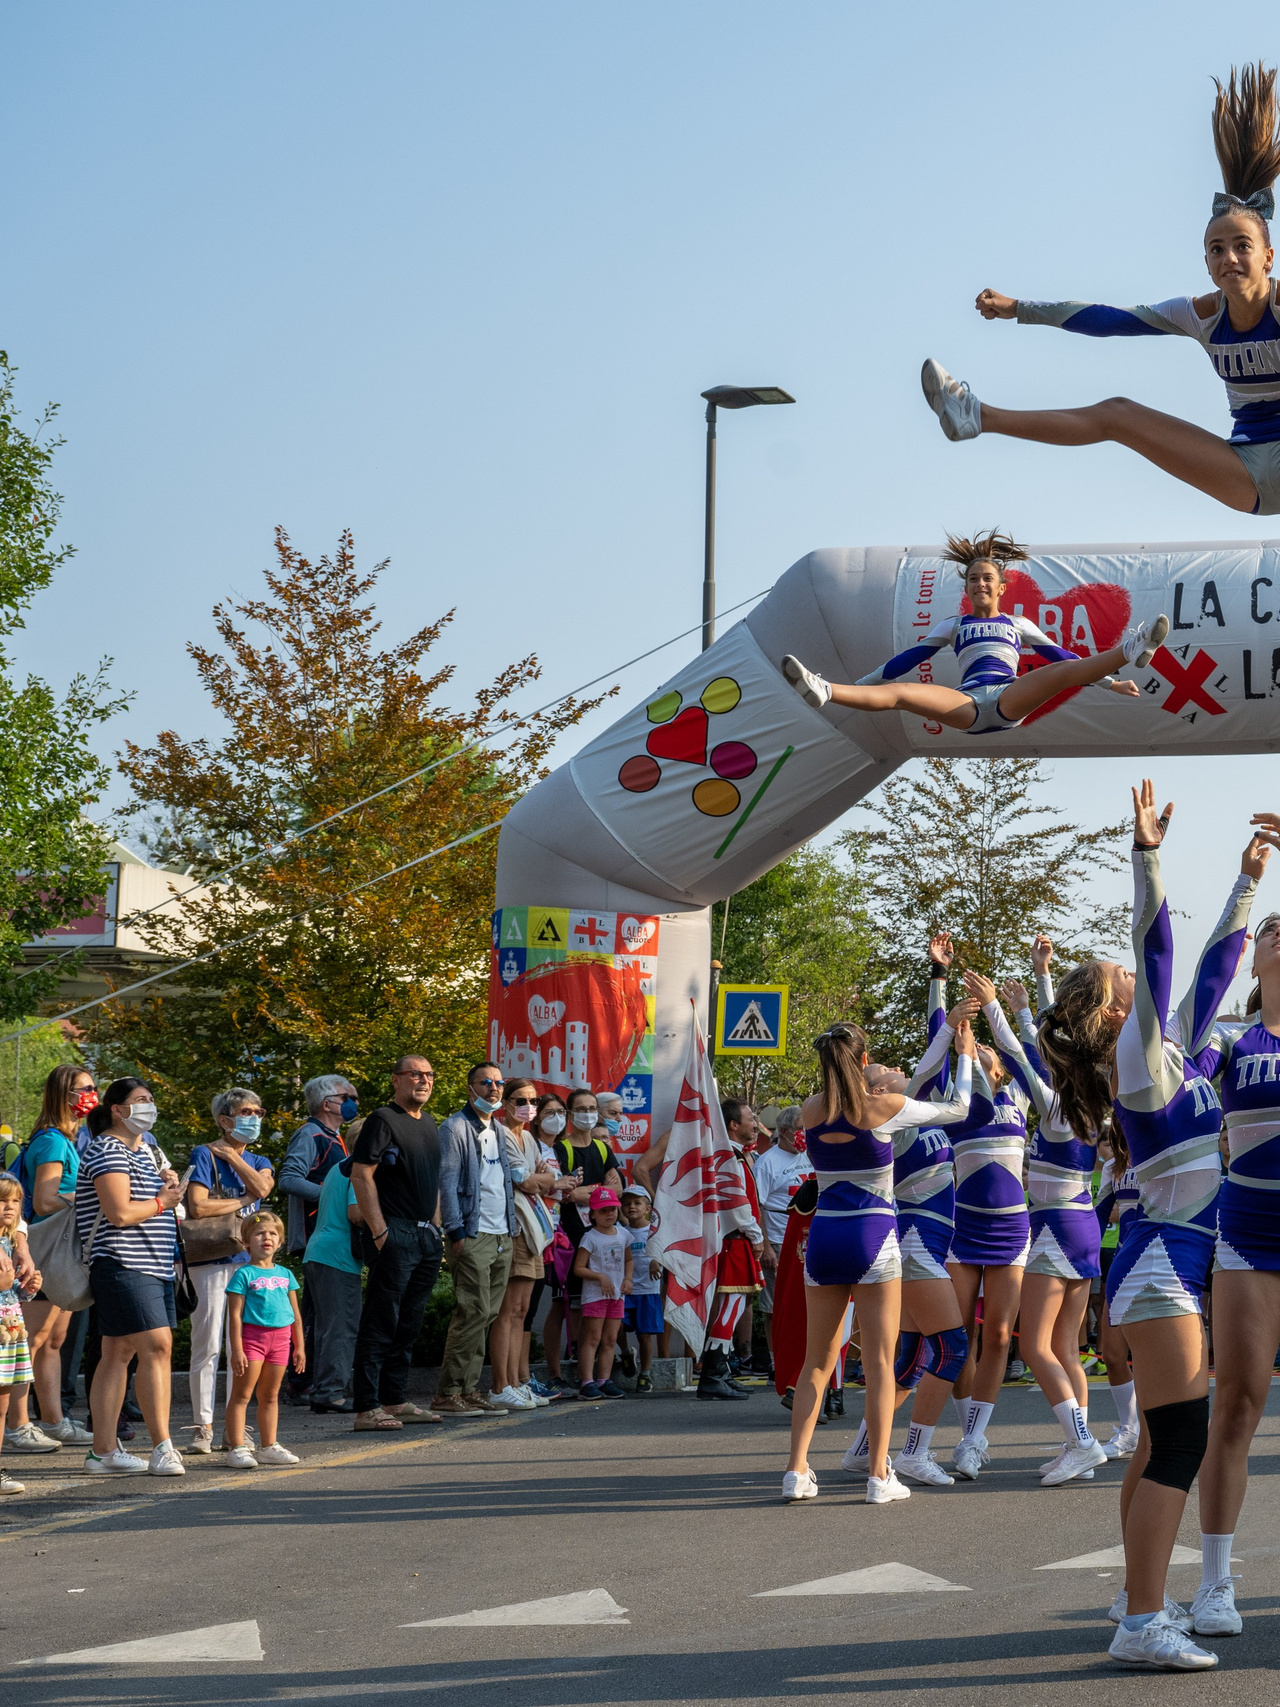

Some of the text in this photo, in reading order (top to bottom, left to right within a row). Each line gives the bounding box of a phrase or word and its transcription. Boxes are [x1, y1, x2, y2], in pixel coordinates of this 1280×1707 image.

[915, 570, 937, 604] torri
[1173, 580, 1225, 630] LA
[956, 623, 1017, 647] TITANS
[626, 926, 648, 938] ALBA
[533, 1005, 557, 1020] ALBA
[619, 1124, 641, 1136] ALBA
[1075, 1407, 1089, 1440] TITANS
[905, 1427, 918, 1455] TITANS
